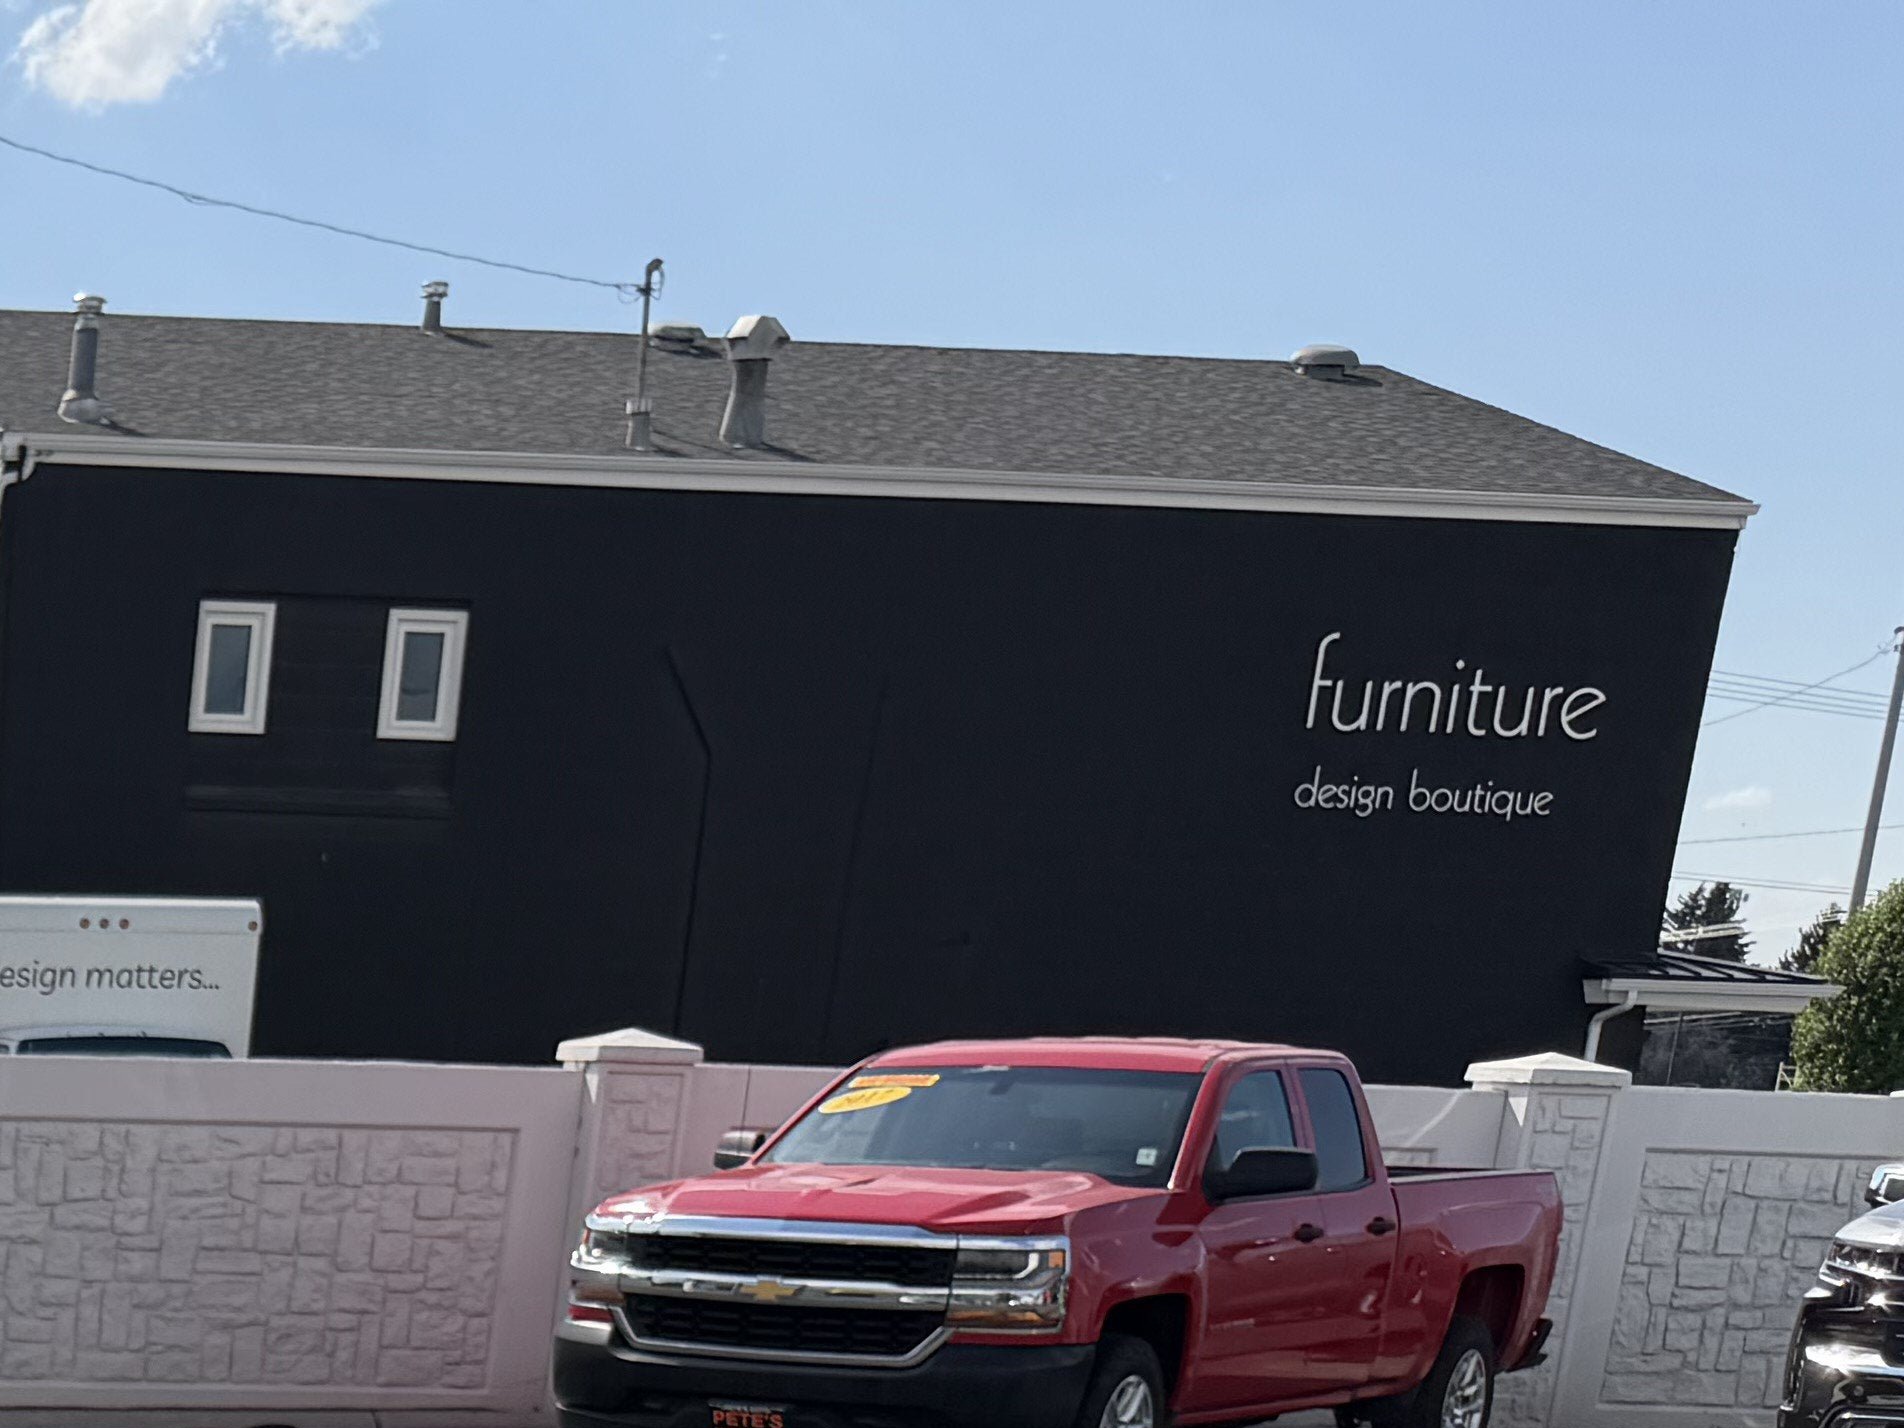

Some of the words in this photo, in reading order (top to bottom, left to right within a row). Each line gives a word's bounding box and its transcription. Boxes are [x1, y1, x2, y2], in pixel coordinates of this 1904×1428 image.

[1306, 631, 1607, 740] furniture
[1294, 765, 1394, 817] design
[1408, 768, 1554, 821] boutique
[85, 963, 221, 991] matters...
